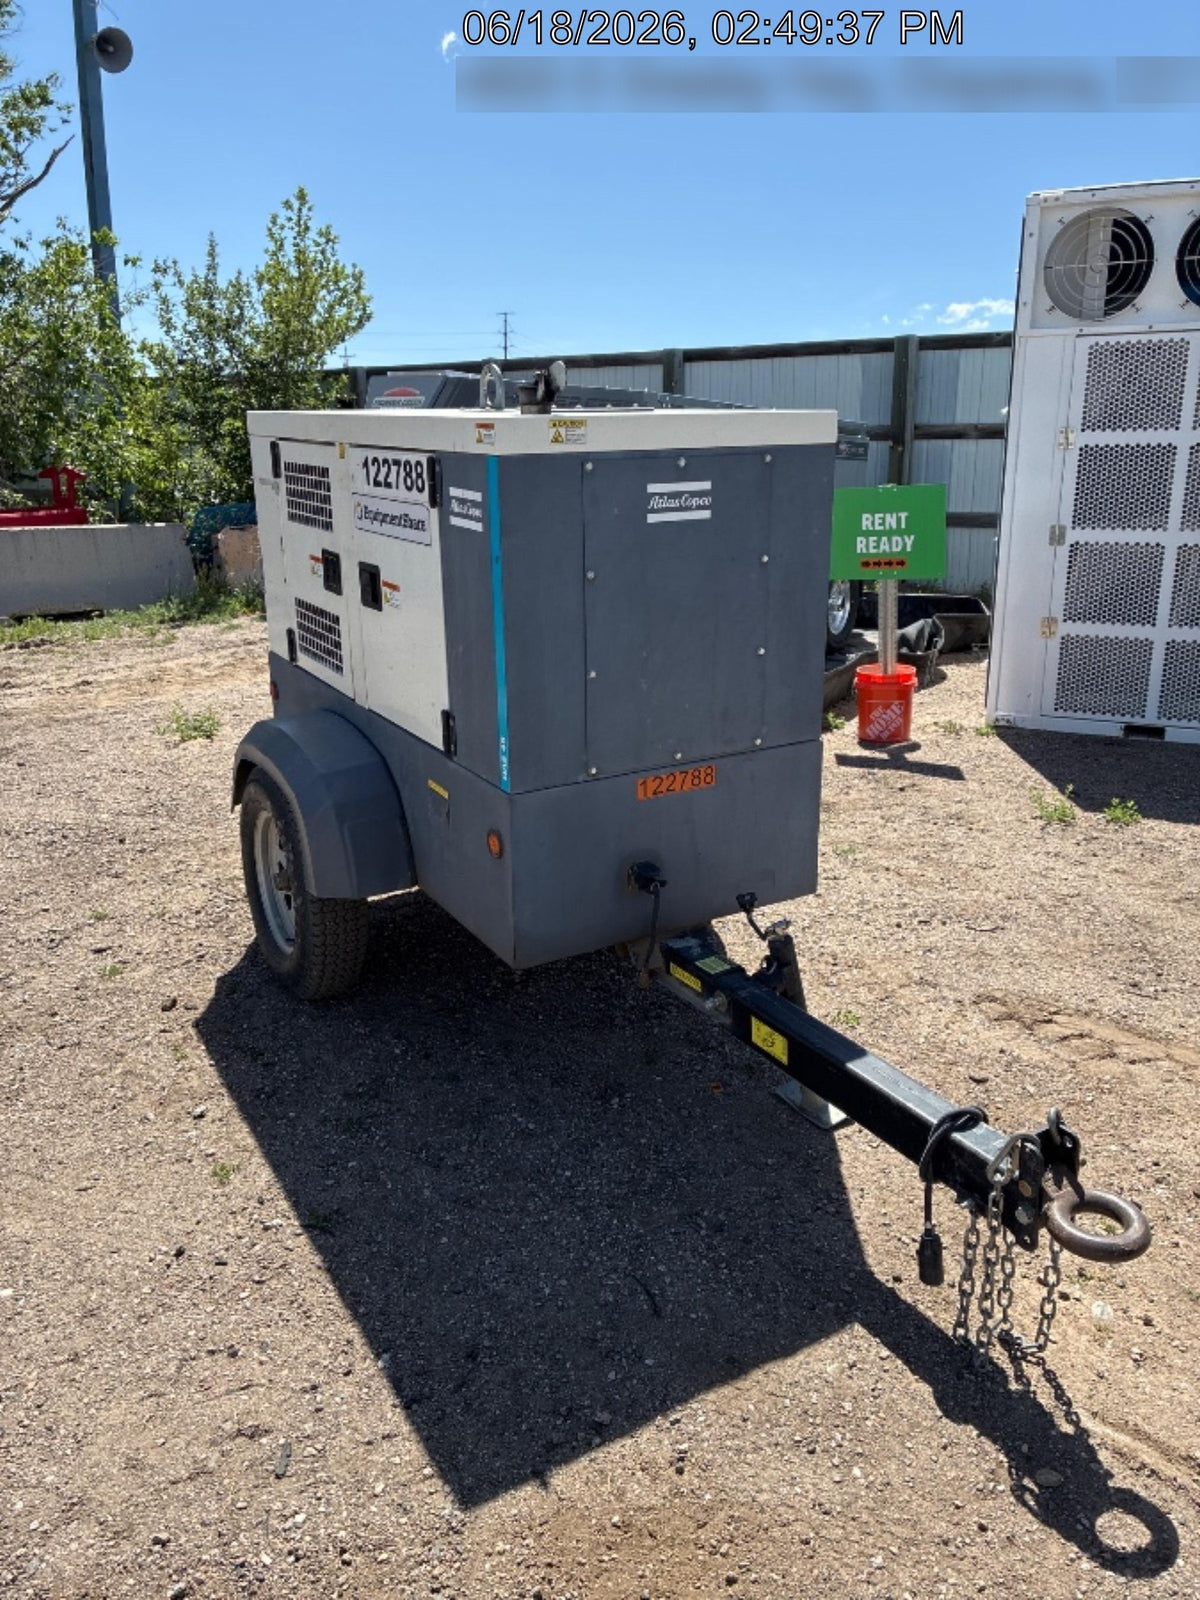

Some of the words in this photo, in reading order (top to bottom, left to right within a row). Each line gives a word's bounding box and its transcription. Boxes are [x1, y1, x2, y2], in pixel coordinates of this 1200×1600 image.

[362, 455, 425, 493] 122788
[649, 496, 679, 509] Atlas
[680, 493, 712, 508] Copco
[861, 512, 909, 530] RENT
[856, 534, 915, 553] READY
[639, 766, 714, 798] 122788
